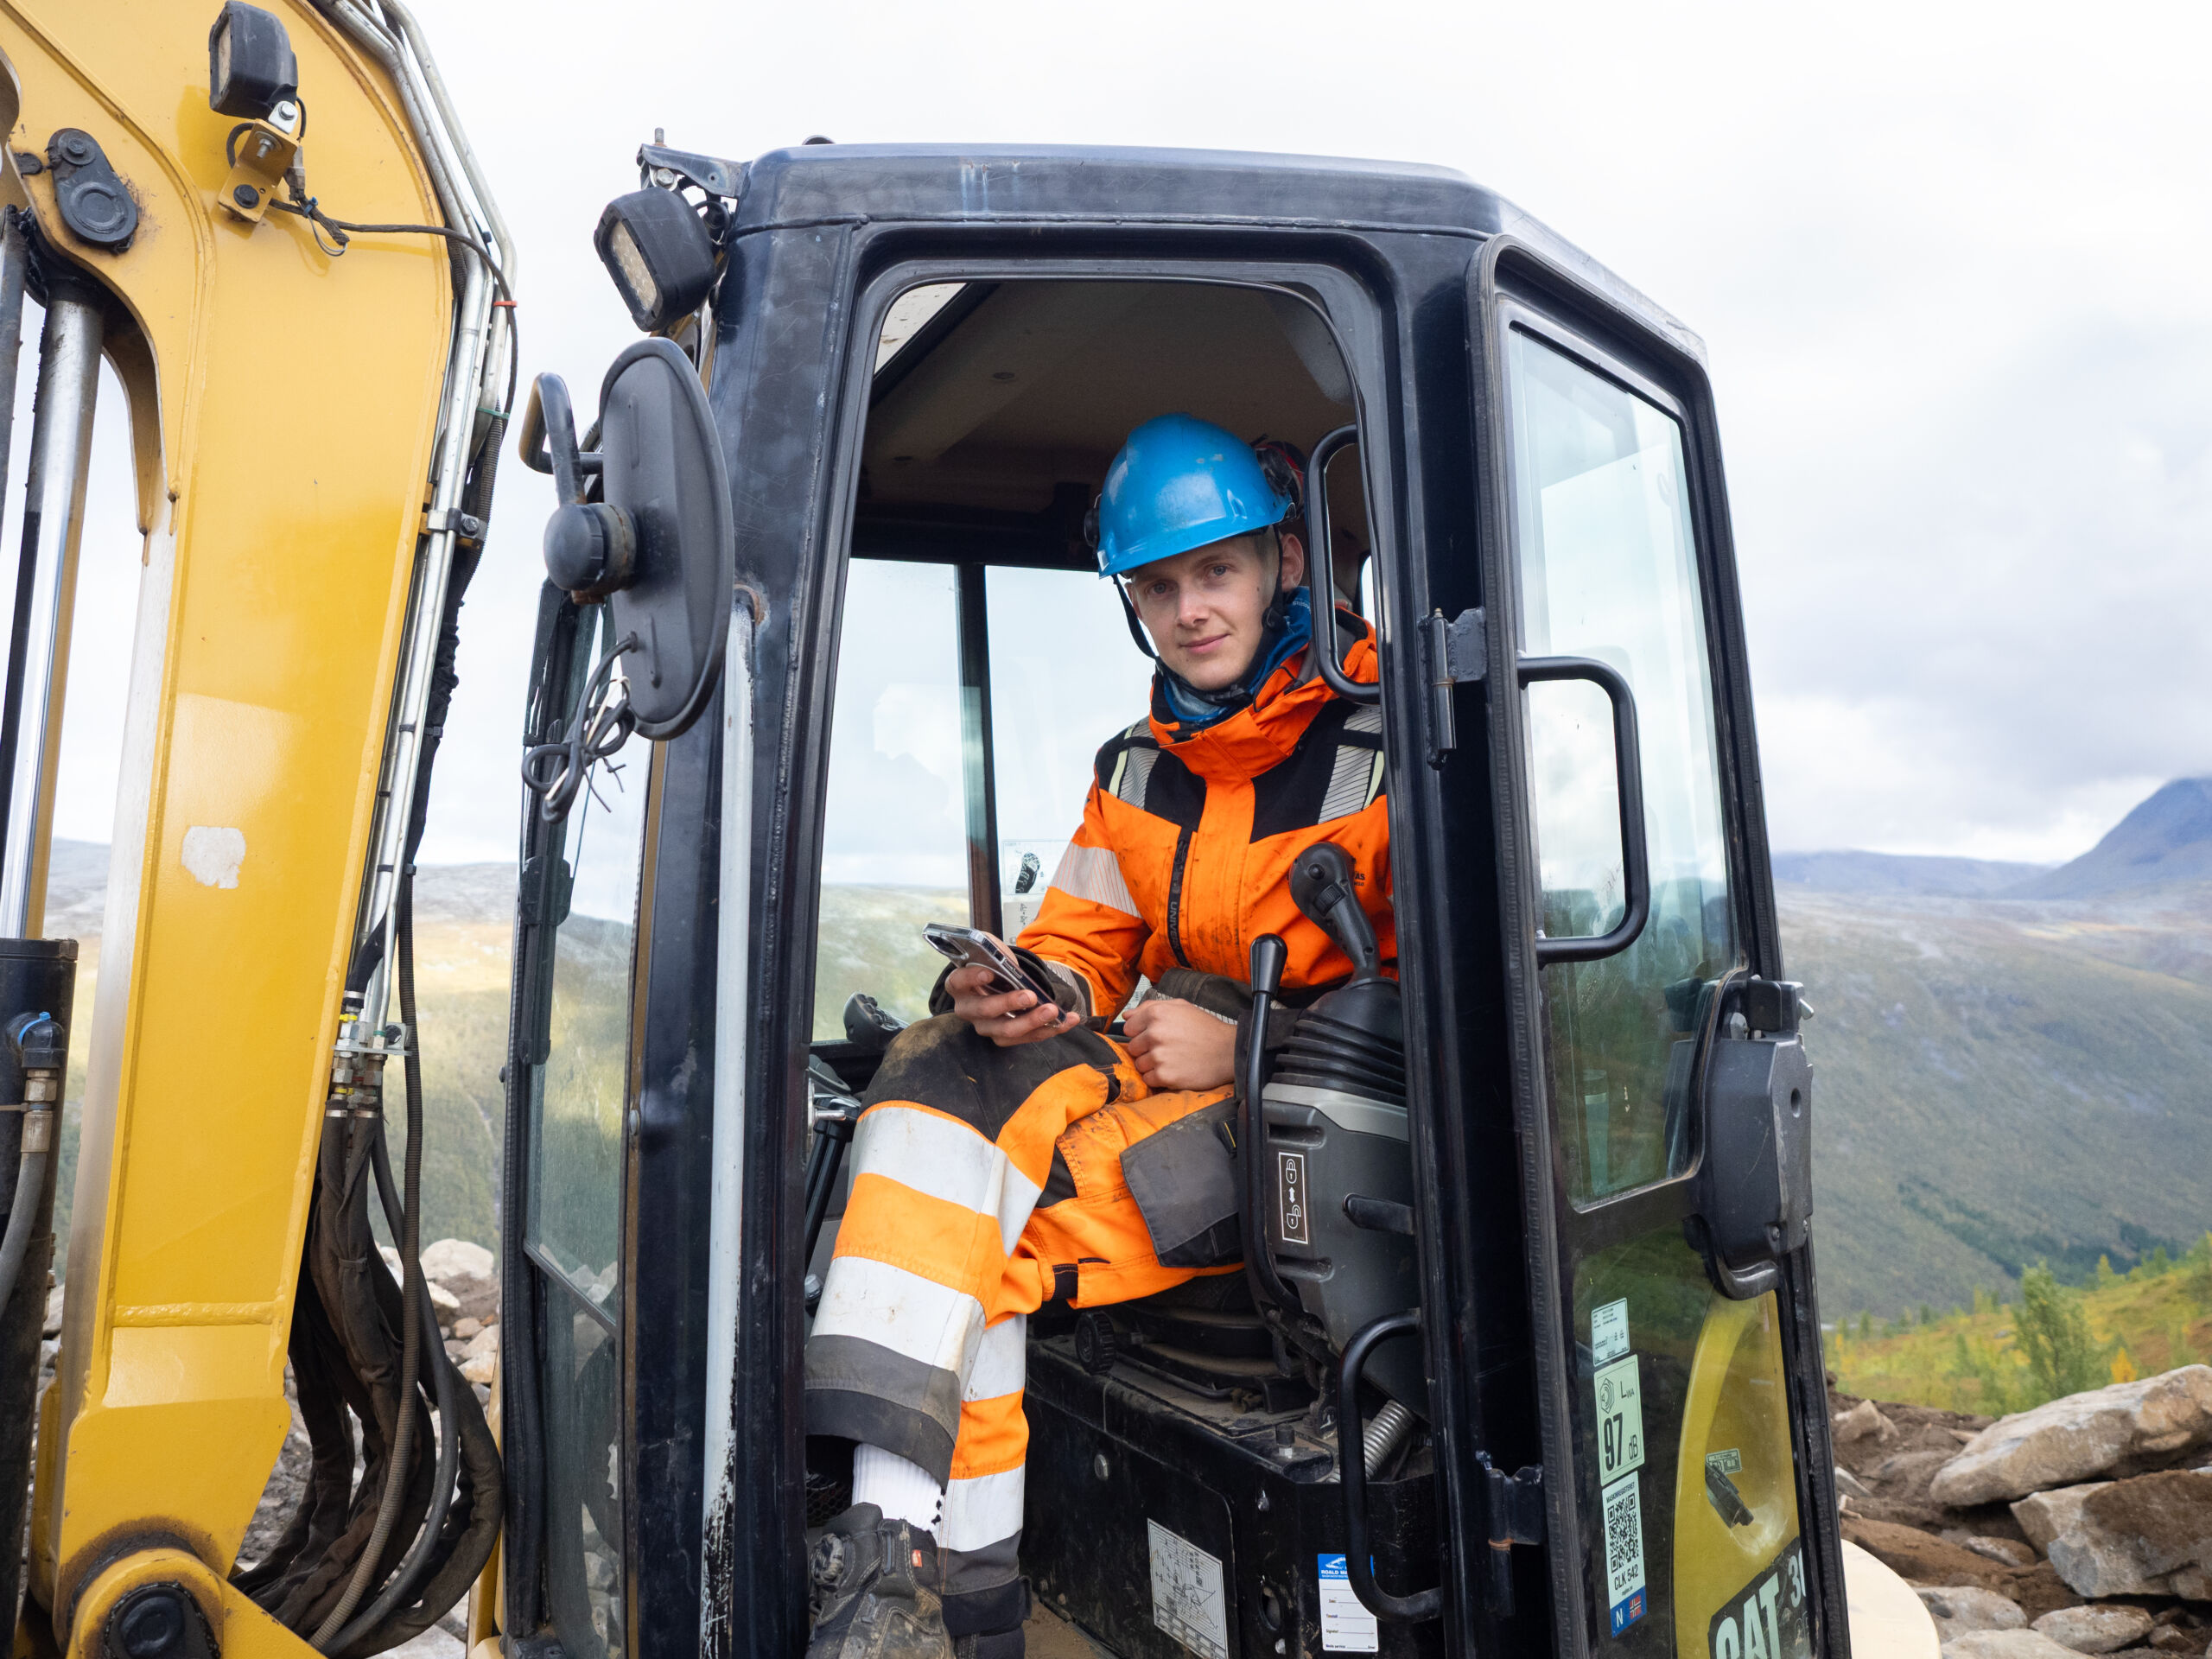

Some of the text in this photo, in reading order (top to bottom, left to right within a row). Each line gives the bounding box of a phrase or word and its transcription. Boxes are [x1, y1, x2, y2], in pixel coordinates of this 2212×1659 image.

[1604, 1413, 1623, 1471] 97
[1628, 1434, 1638, 1460] dB
[1614, 1571, 1626, 1591] CLK
[1627, 1564, 1639, 1582] 542
[1616, 1608, 1624, 1628] N
